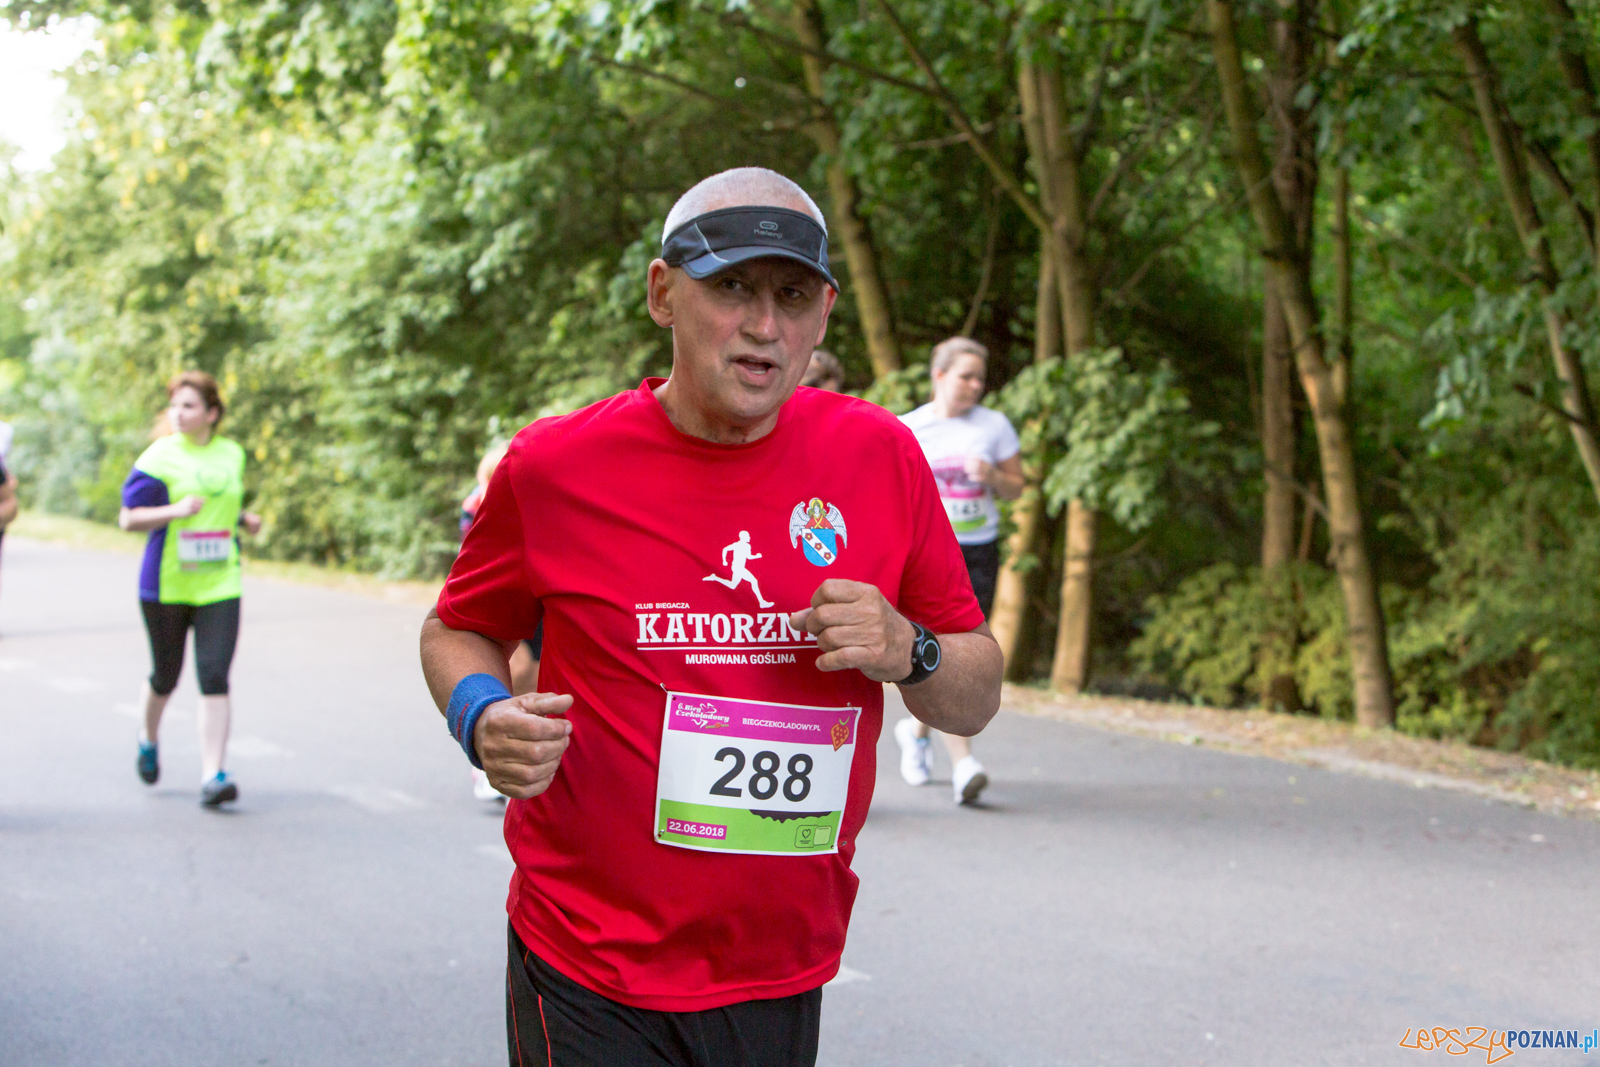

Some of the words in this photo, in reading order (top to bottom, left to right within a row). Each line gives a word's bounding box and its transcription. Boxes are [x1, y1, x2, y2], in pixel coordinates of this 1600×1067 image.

[685, 655, 748, 665] MUROWANA
[750, 653, 796, 664] GOŚLINA
[684, 704, 701, 713] Bieg
[675, 709, 730, 723] Czekoladowy
[742, 717, 821, 732] BIEGCZEKOLADOWY.PL
[709, 747, 813, 802] 288
[669, 821, 724, 837] 22.06.2018
